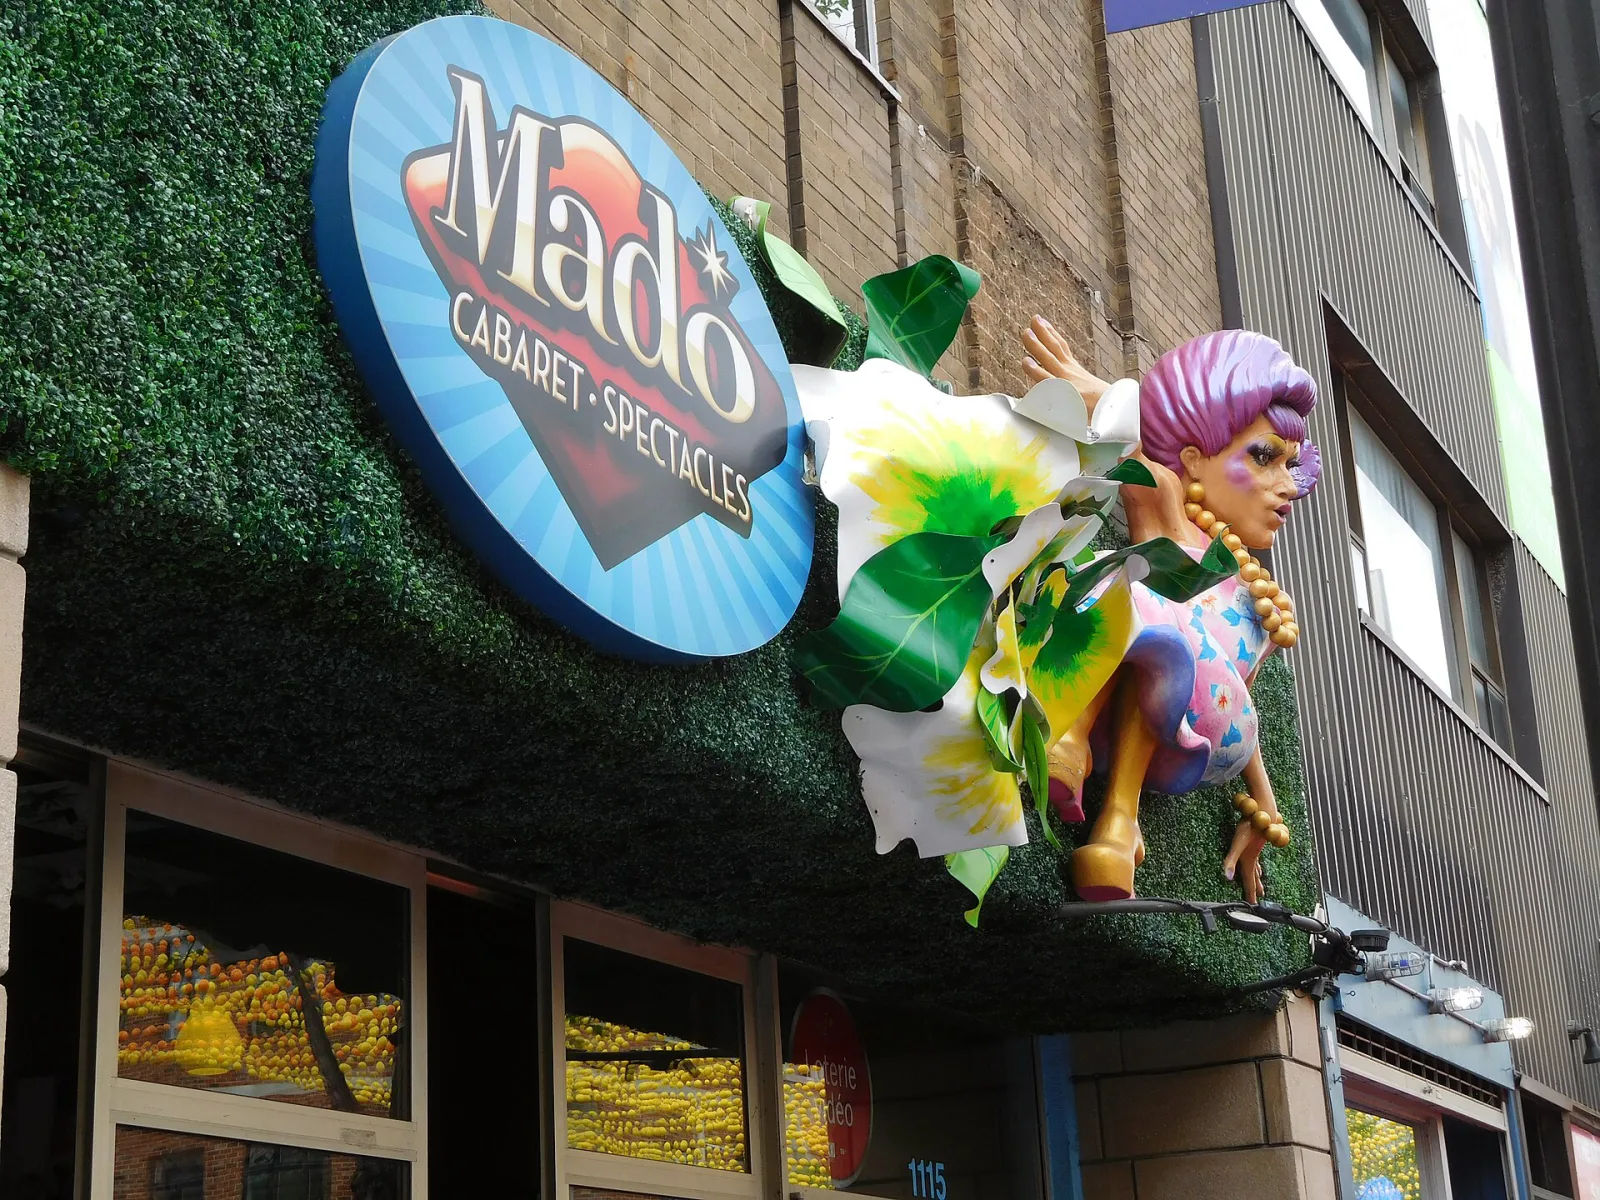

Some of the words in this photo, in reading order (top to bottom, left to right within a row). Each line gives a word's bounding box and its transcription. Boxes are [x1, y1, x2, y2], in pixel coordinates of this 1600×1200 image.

[434, 72, 756, 423] Mado
[453, 291, 585, 412] CABARET
[602, 385, 751, 523] SPECTACLES
[812, 1092, 854, 1127] déo
[908, 1157, 947, 1200] 1115
